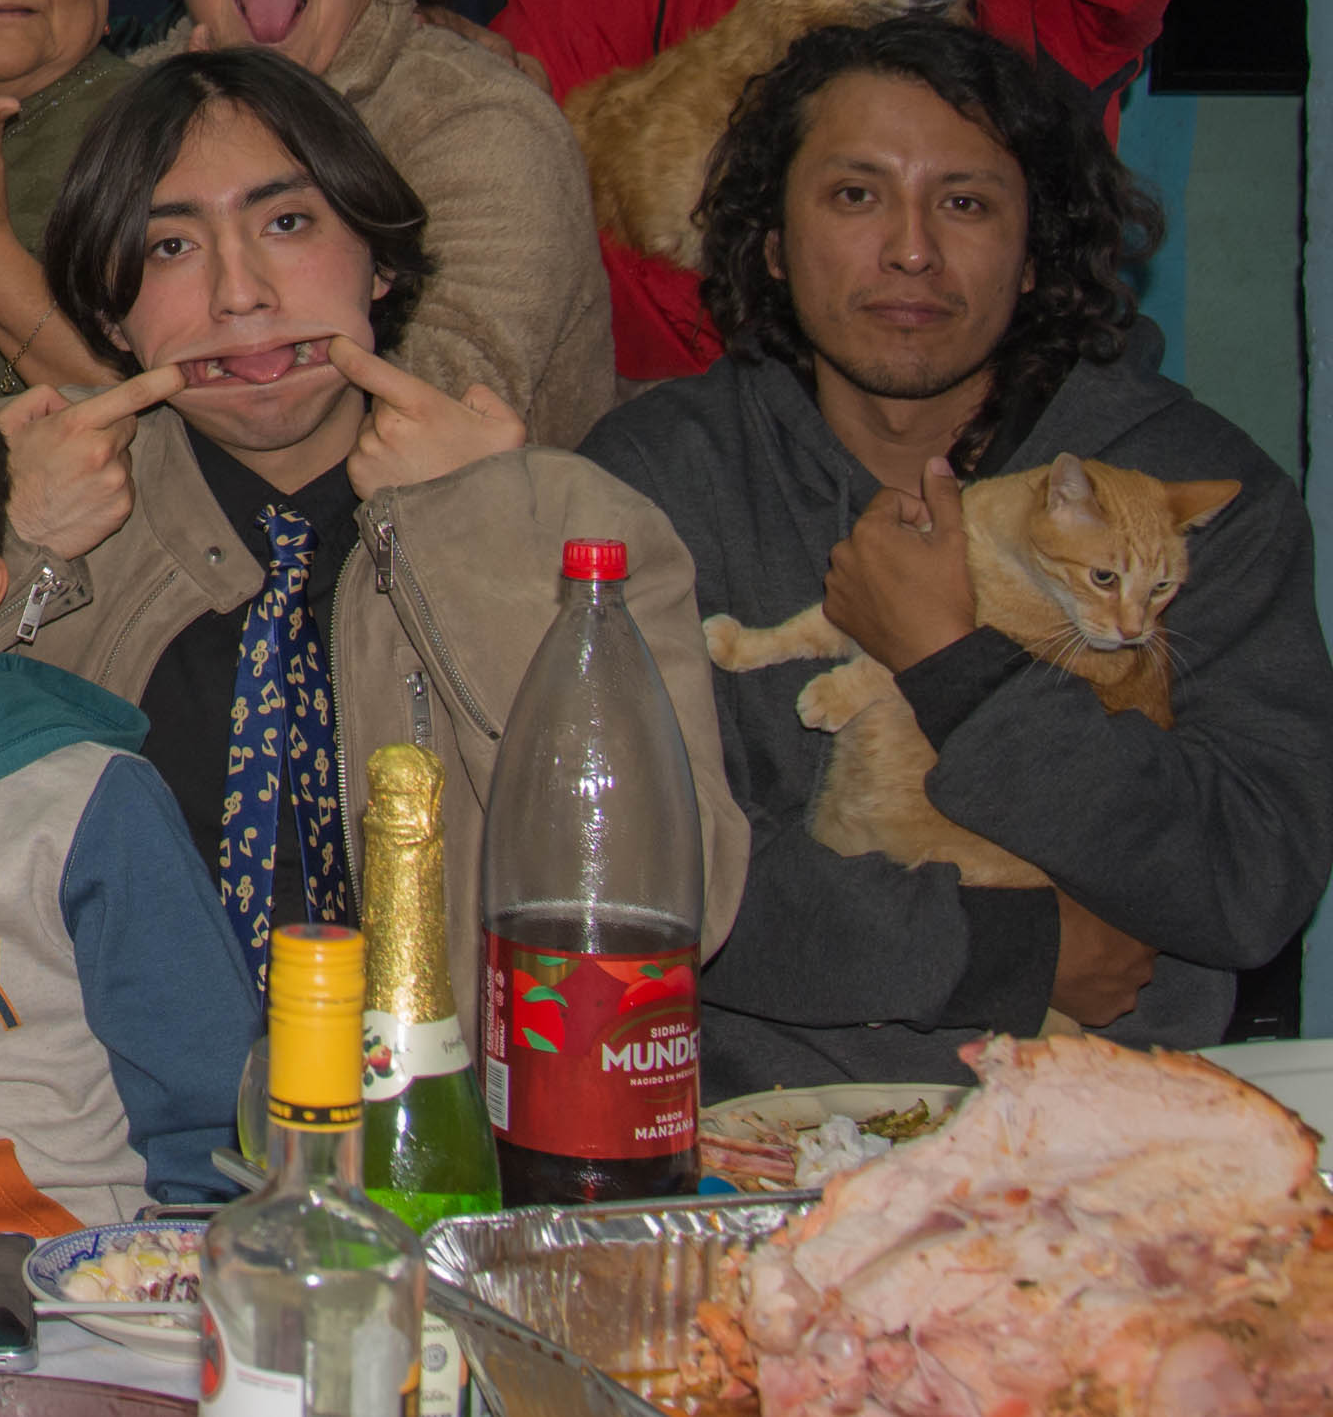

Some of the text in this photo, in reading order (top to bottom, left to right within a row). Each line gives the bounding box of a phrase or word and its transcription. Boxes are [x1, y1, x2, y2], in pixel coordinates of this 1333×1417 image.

[650, 1023, 686, 1039] SIDRAL
[629, 1076, 664, 1086] NACIDO
[655, 1110, 683, 1124] SABOR
